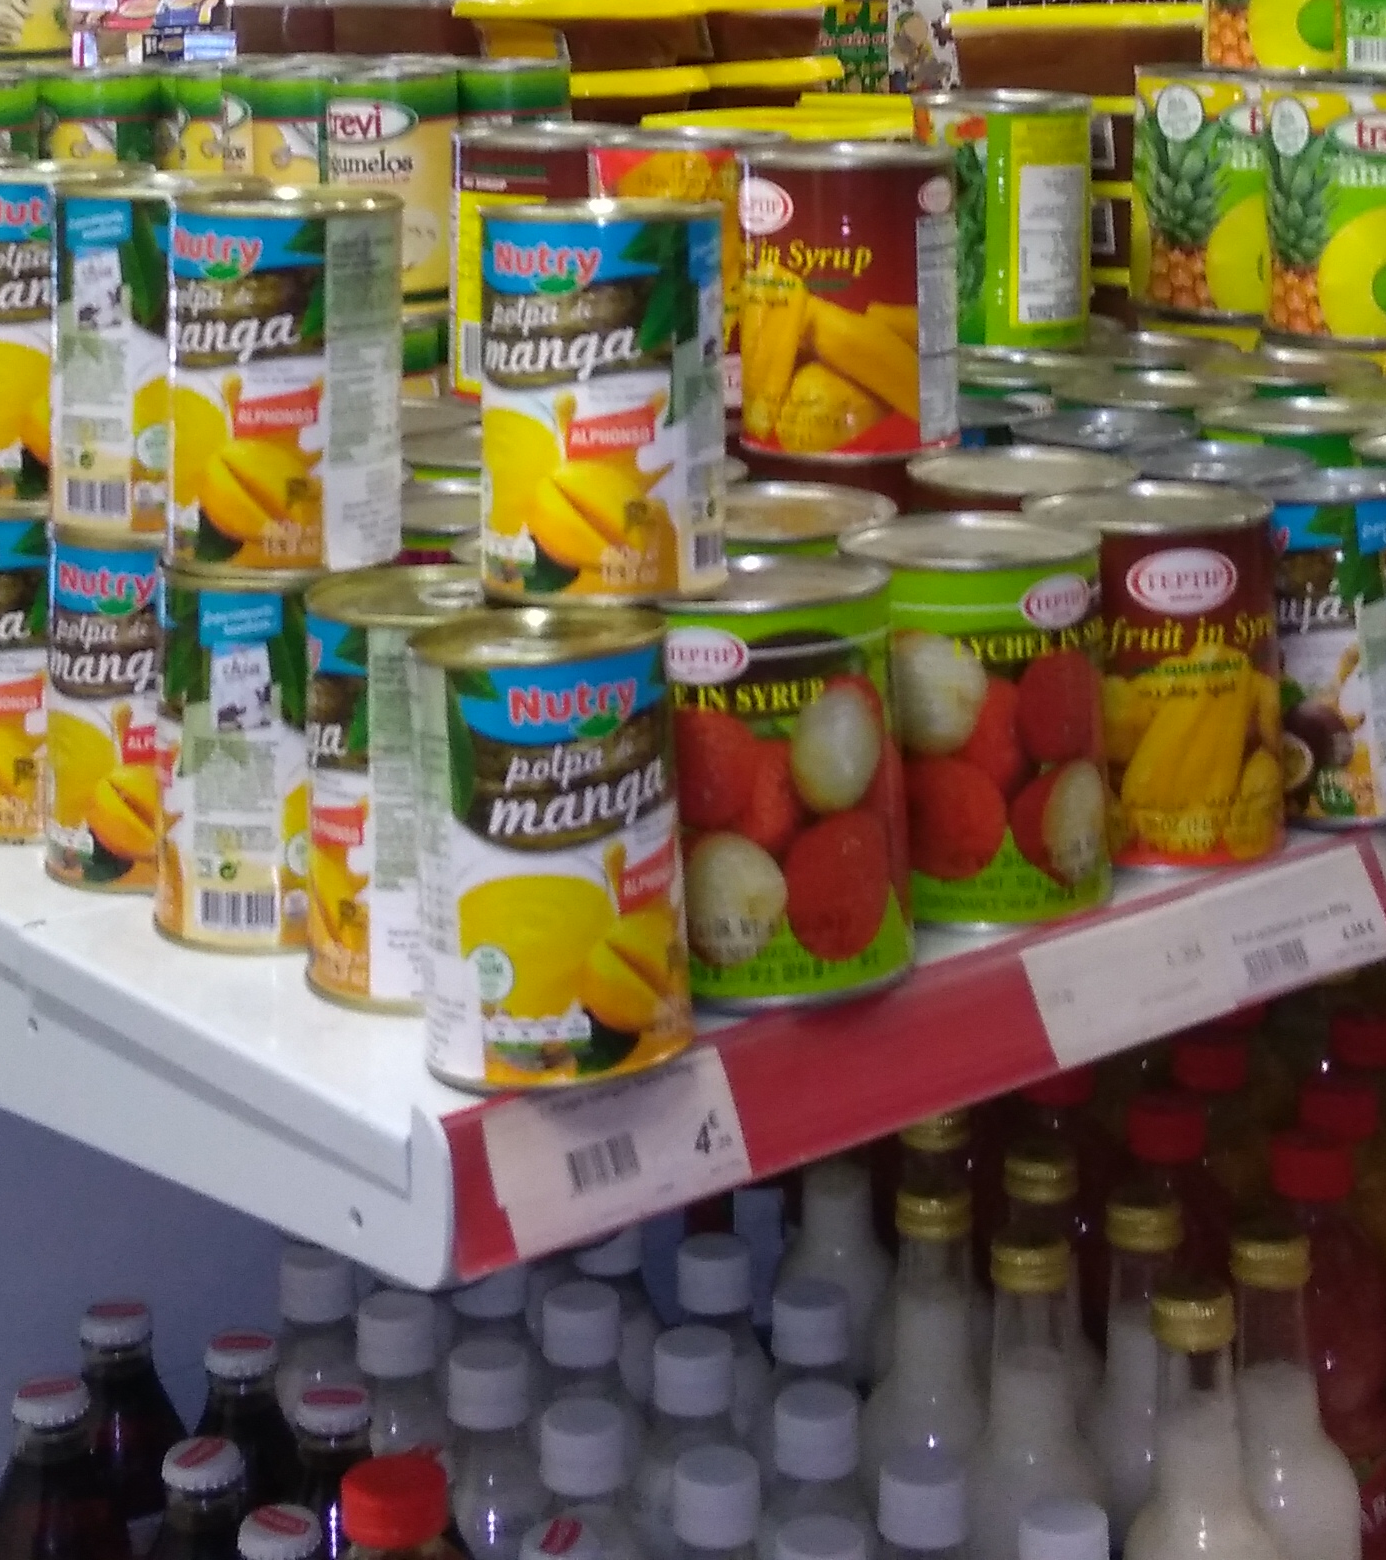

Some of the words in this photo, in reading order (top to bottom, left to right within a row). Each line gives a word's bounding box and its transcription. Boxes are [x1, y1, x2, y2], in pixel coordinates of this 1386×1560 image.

[174, 227, 263, 275] Nutry
[493, 240, 603, 287] Nutry
[787, 238, 873, 277] Syrup
[482, 326, 643, 381] manga
[59, 562, 157, 608] Nutry
[49, 647, 155, 693] mang
[509, 677, 637, 726] Nutry
[735, 677, 826, 714] SYRUP
[504, 743, 603, 792] polpa
[487, 754, 664, 836] manga
